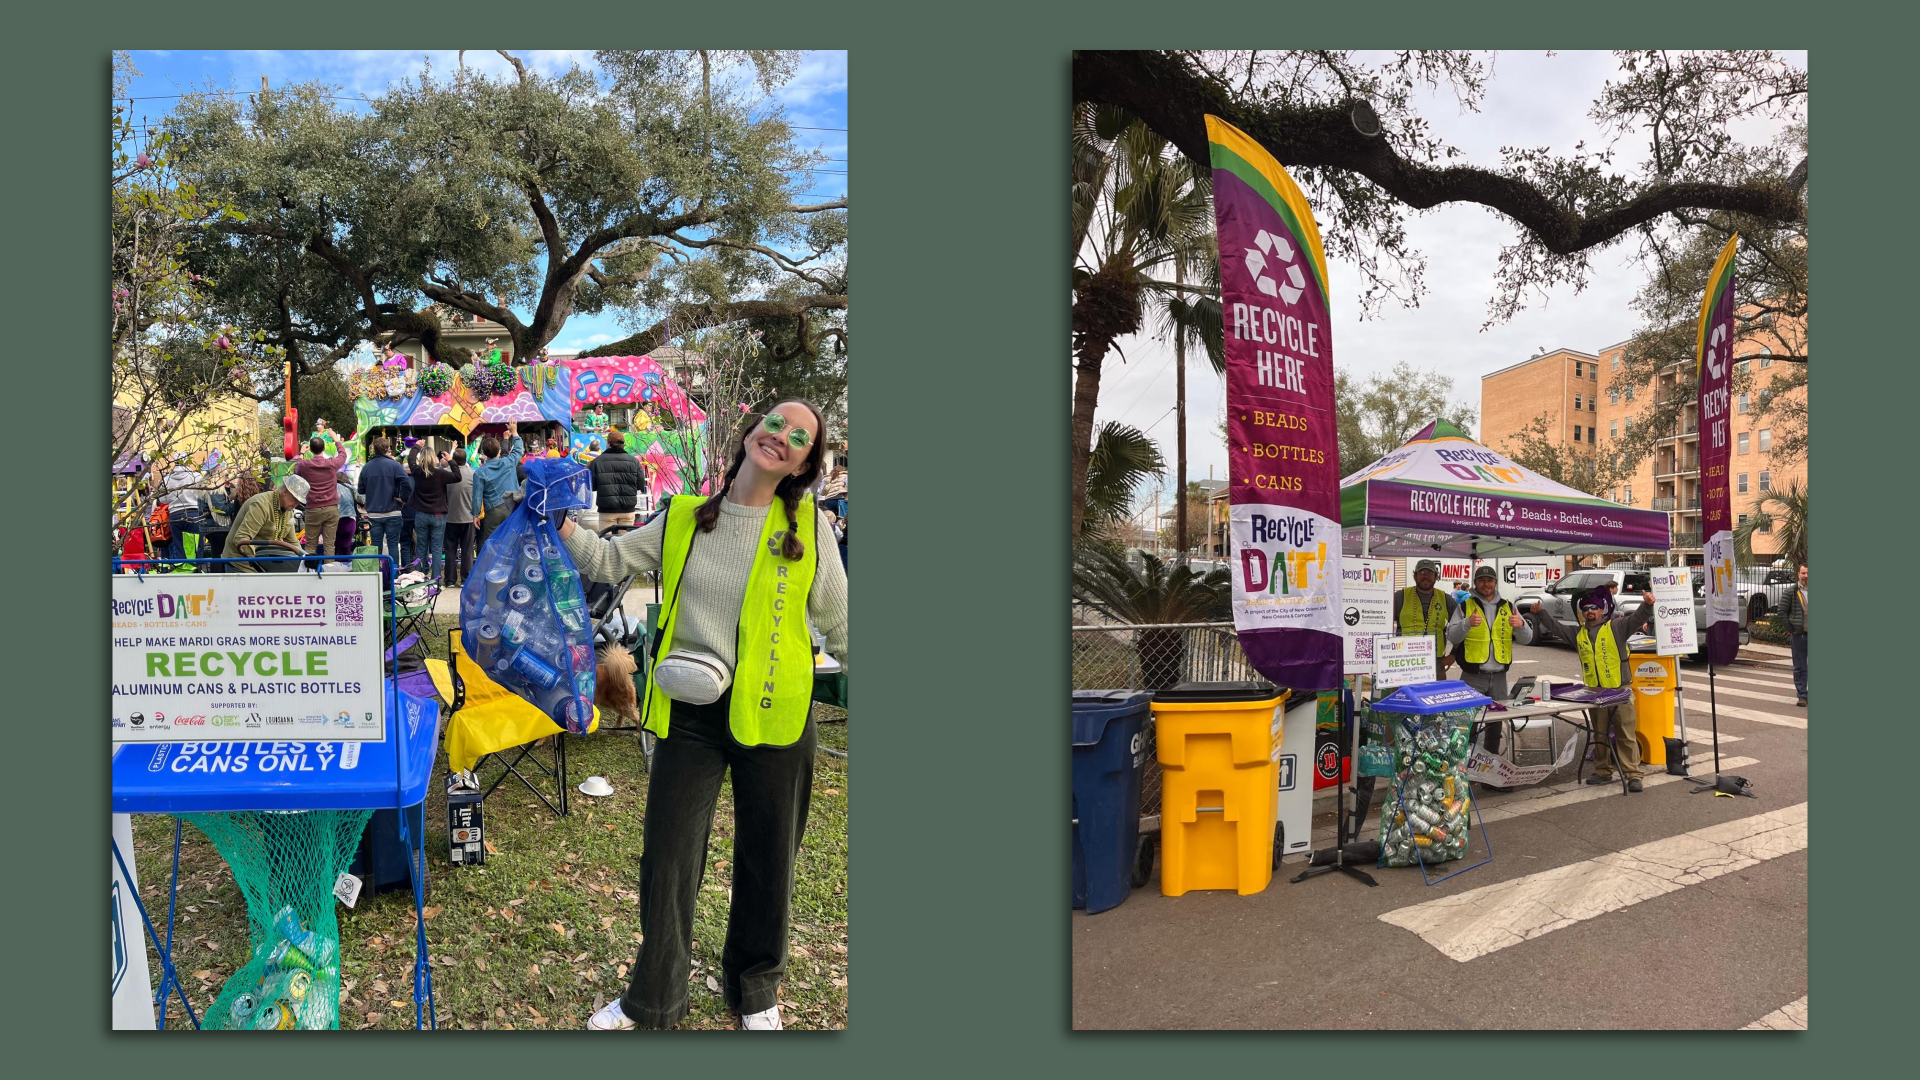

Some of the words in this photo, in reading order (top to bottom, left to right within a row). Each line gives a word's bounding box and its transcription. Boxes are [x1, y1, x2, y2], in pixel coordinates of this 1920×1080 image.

[1233, 303, 1319, 358] RECYCLE
[1257, 350, 1307, 395] HERE
[1254, 410, 1308, 432] BEADS
[1253, 443, 1324, 464] BOTTLES
[1255, 474, 1302, 491] CANS
[1410, 490, 1460, 516] RECYCLE
[1463, 496, 1492, 518] HERE
[1521, 508, 1551, 522] Beads
[1559, 511, 1593, 526] Bottles
[1600, 516, 1623, 528] Cans
[1240, 542, 1327, 594] DAT!
[1442, 565, 1470, 579] MINI'S
[156, 589, 214, 619] DAT!
[238, 596, 302, 605] RECYCLE
[307, 596, 326, 605] TO
[238, 609, 265, 618] WIN
[271, 609, 326, 618] PRIZES!
[114, 638, 142, 647] HELP
[146, 637, 176, 647] MAKE
[180, 637, 213, 646] MARDI
[216, 636, 246, 646] GRAS
[250, 636, 280, 645] MORE
[284, 636, 357, 645] SUSTAINABLE
[760, 566, 788, 709] RECYCLING
[146, 651, 328, 677] RECYCLE
[1389, 658, 1426, 668] RECYCLE
[1601, 638, 1611, 678] RECYCLING
[112, 684, 182, 695] ALUMINUM
[187, 683, 223, 694] CANS
[228, 683, 236, 694] &
[241, 682, 296, 694] PLASTIC
[301, 682, 361, 694] BOTTLES
[153, 744, 168, 768] PLASTIC
[180, 742, 306, 755] BOTTLES
[171, 755, 249, 772] CANS
[259, 754, 336, 772] ONLY
[1324, 753, 1336, 770] JJ
[1499, 763, 1514, 775] FREE
[459, 808, 472, 827] Lite
[469, 828, 477, 840] Lite
